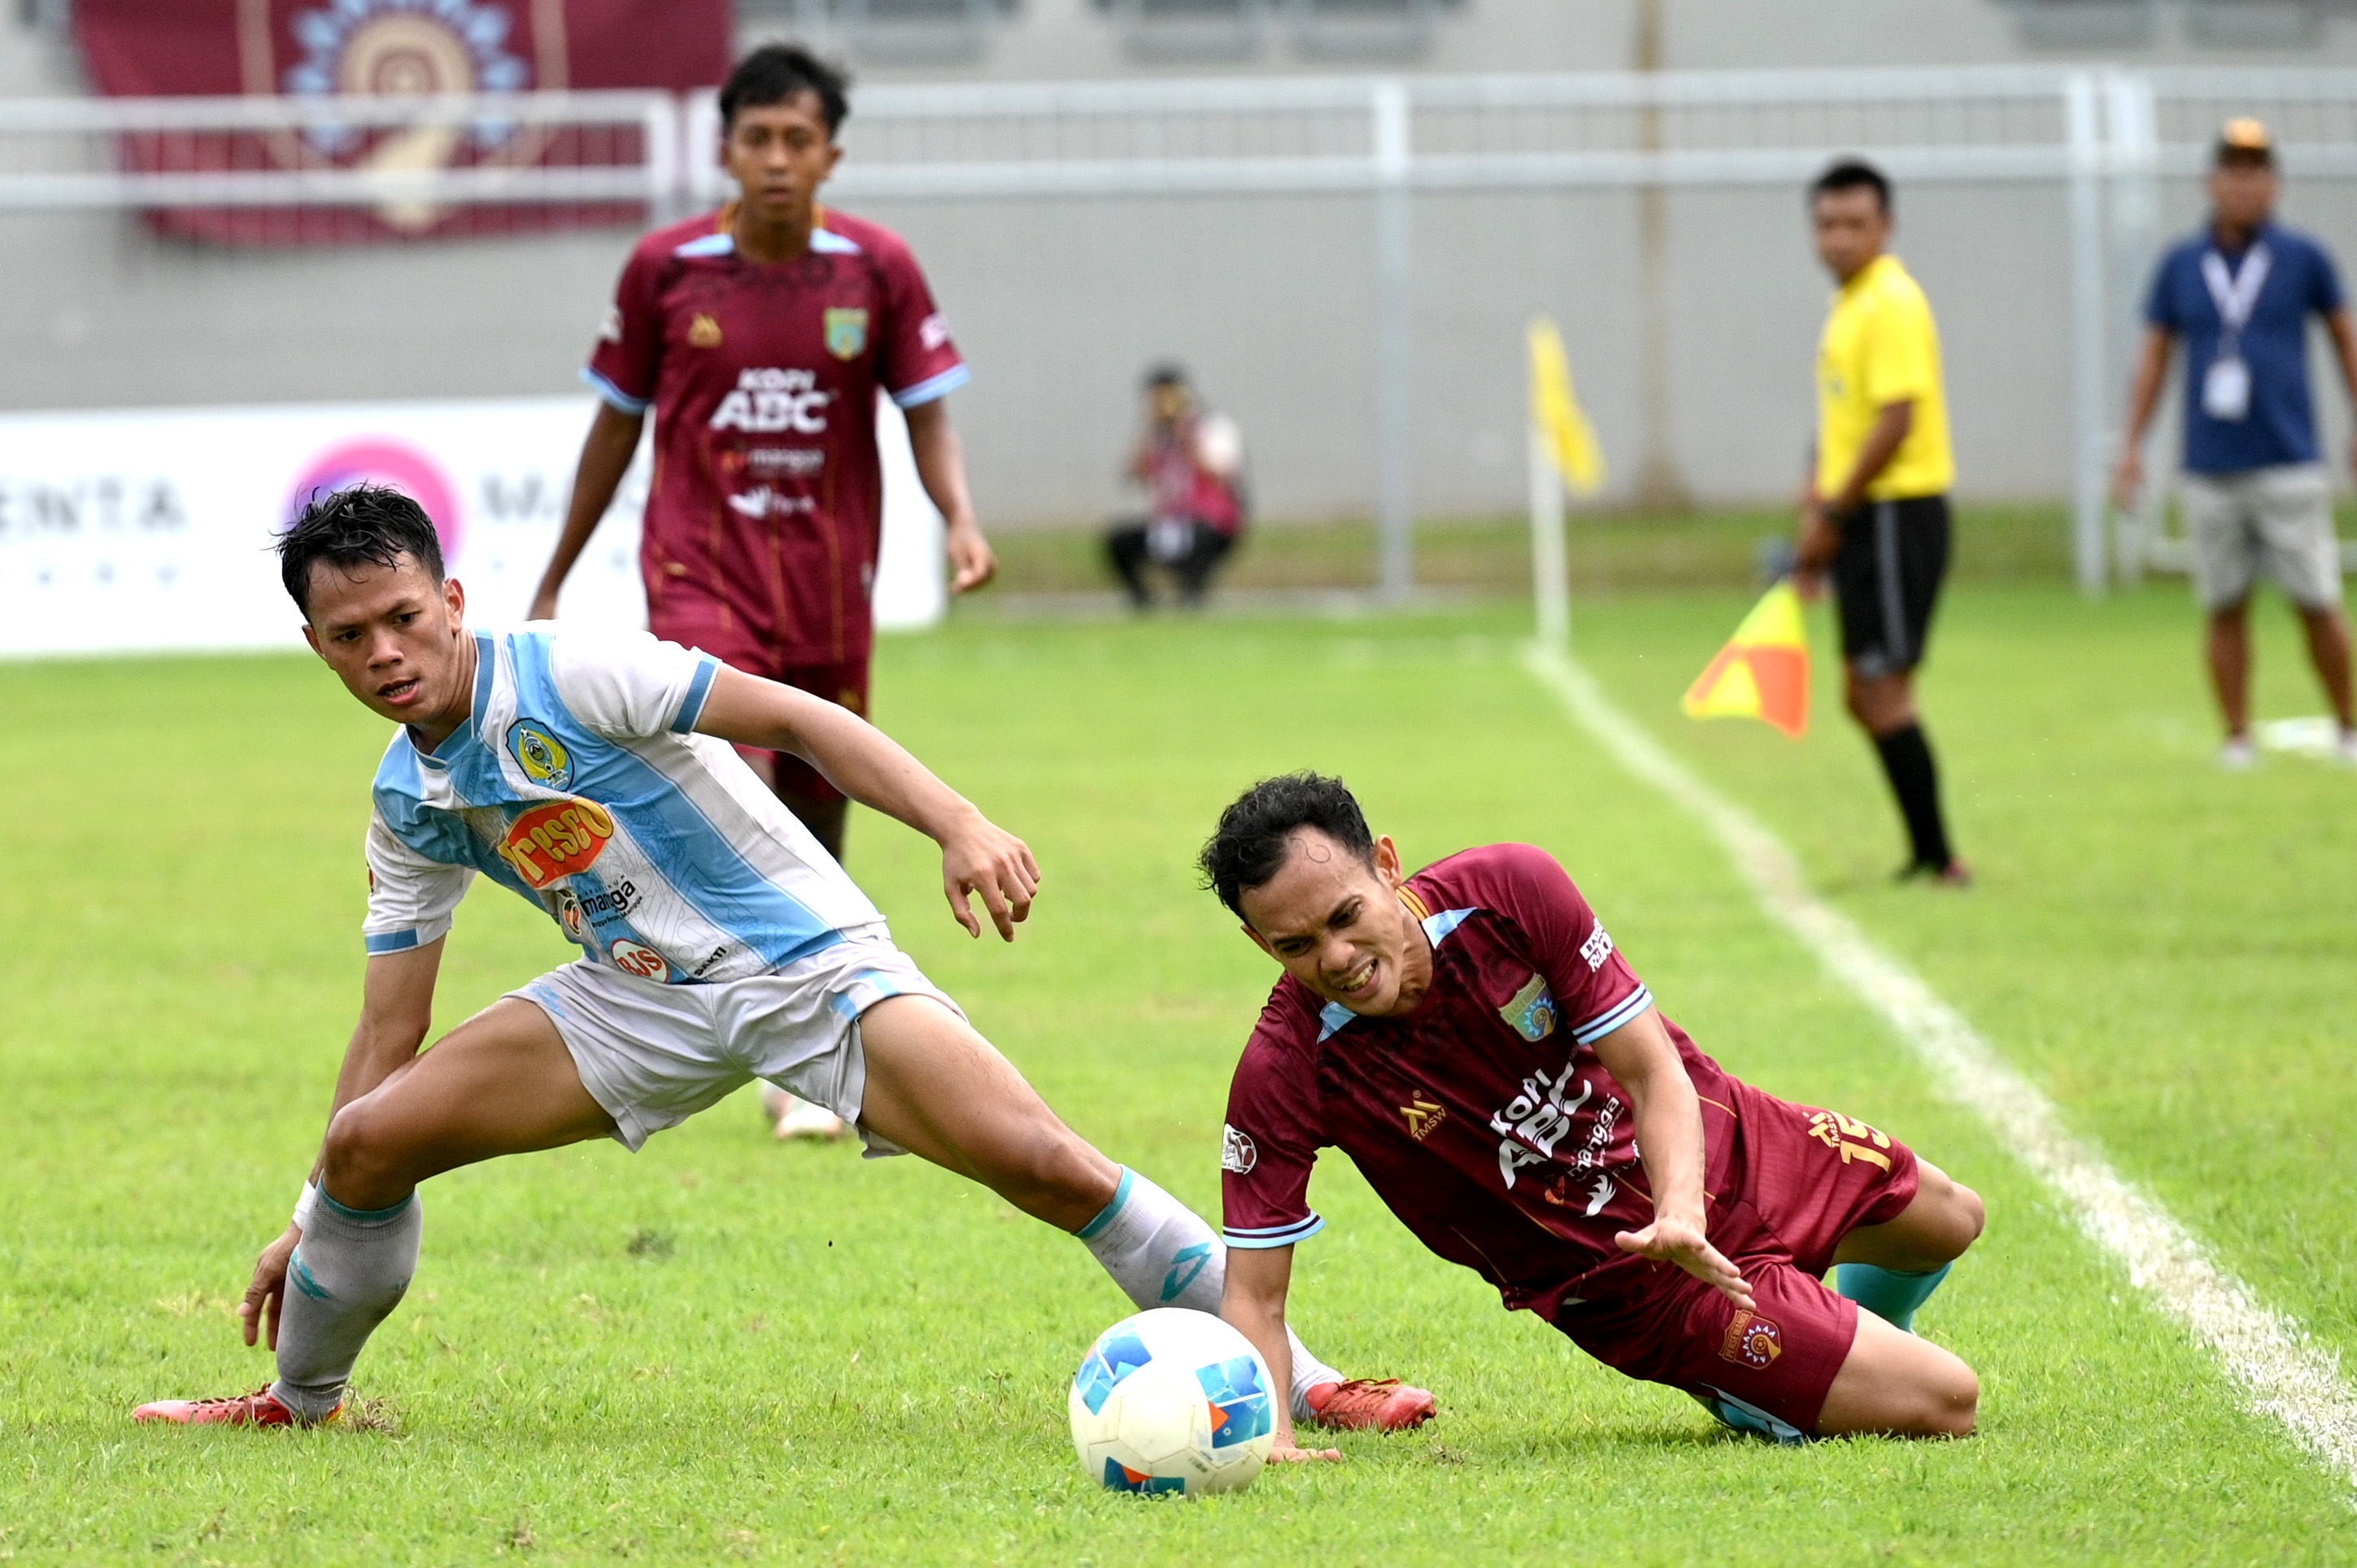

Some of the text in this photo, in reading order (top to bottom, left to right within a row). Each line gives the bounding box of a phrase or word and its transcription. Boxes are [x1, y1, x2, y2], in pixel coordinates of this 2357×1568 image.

[738, 368, 816, 391] KOPI
[708, 390, 829, 433] ABC
[497, 796, 614, 882] resco
[694, 946, 727, 976] SAKTI
[1412, 1107, 1446, 1140] TMSW
[1489, 1068, 1552, 1137] KOPI
[1499, 1061, 1592, 1191] ABC
[1829, 1110, 1891, 1173] 15
